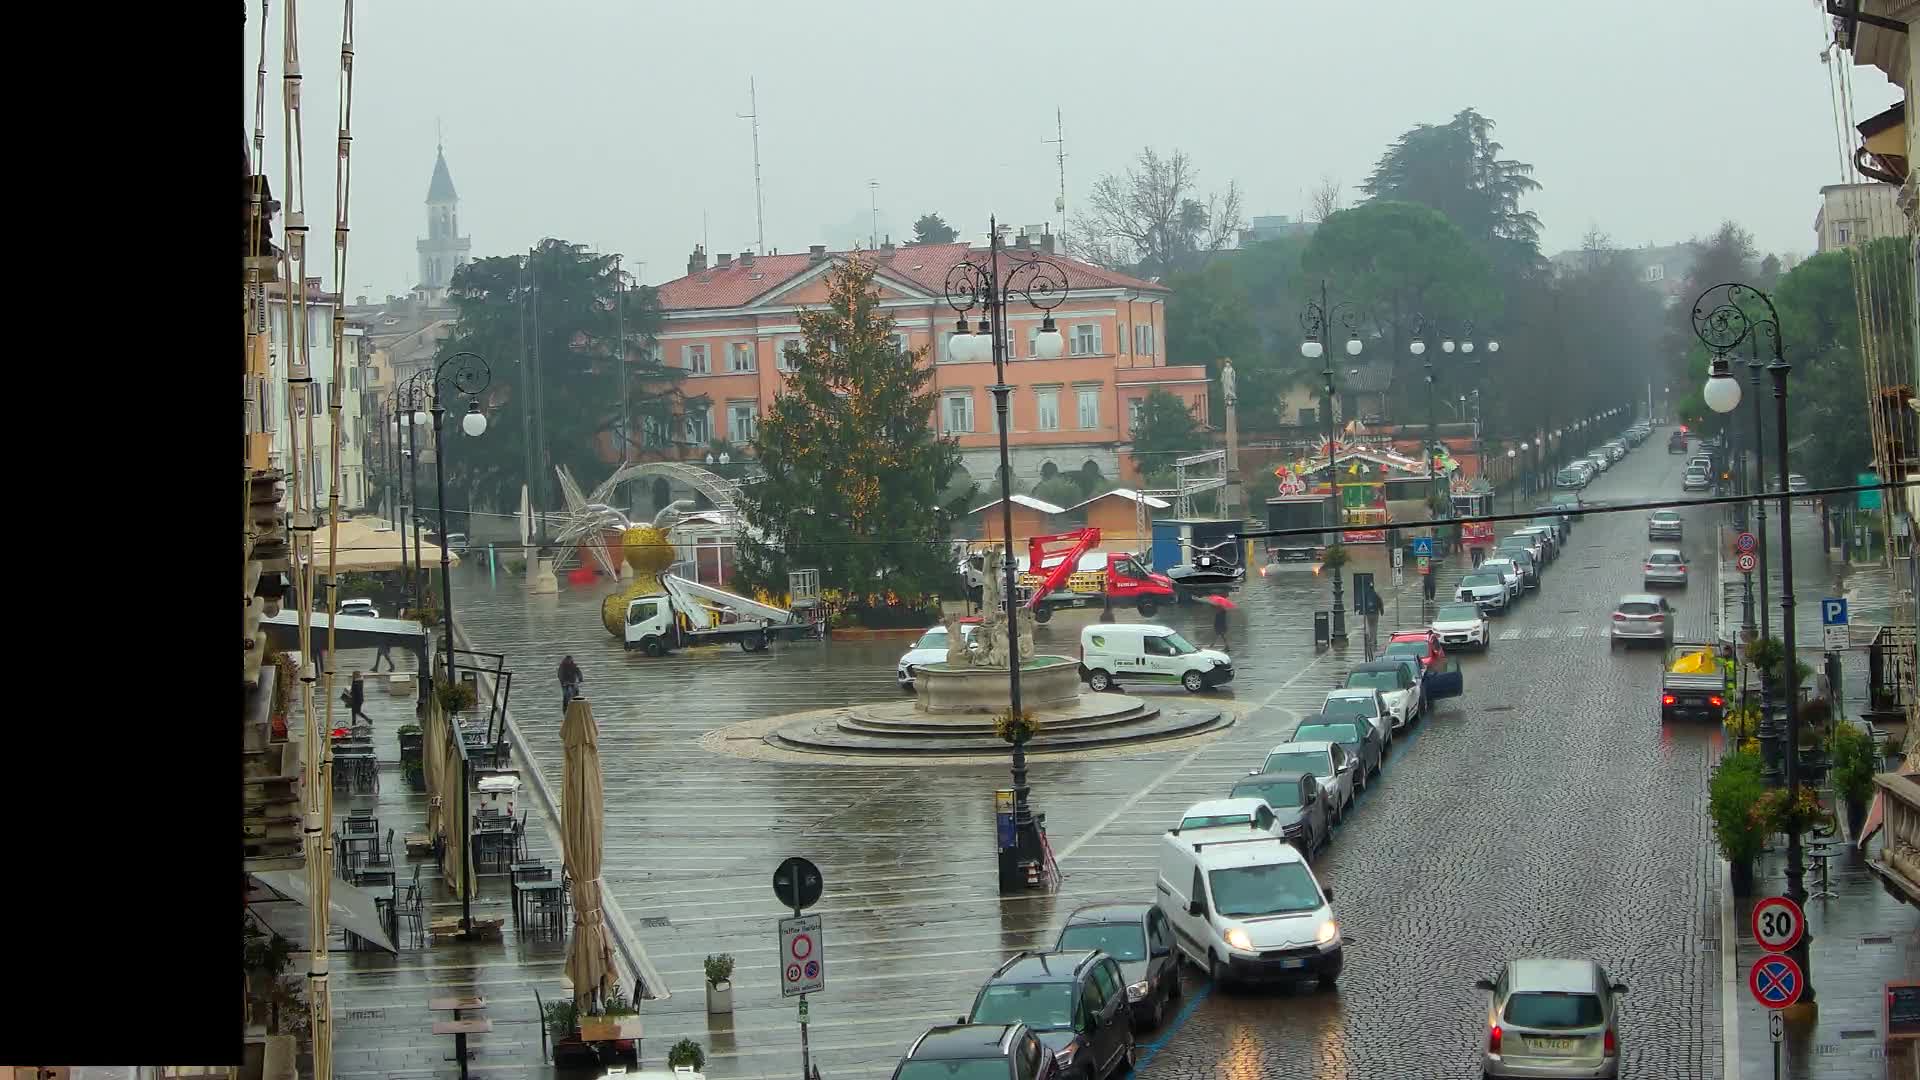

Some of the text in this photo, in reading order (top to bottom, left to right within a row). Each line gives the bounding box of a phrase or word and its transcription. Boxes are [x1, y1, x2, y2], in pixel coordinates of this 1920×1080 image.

[1742, 557, 1753, 567] 20
[1827, 602, 1842, 621] P
[1762, 911, 1791, 937] 30
